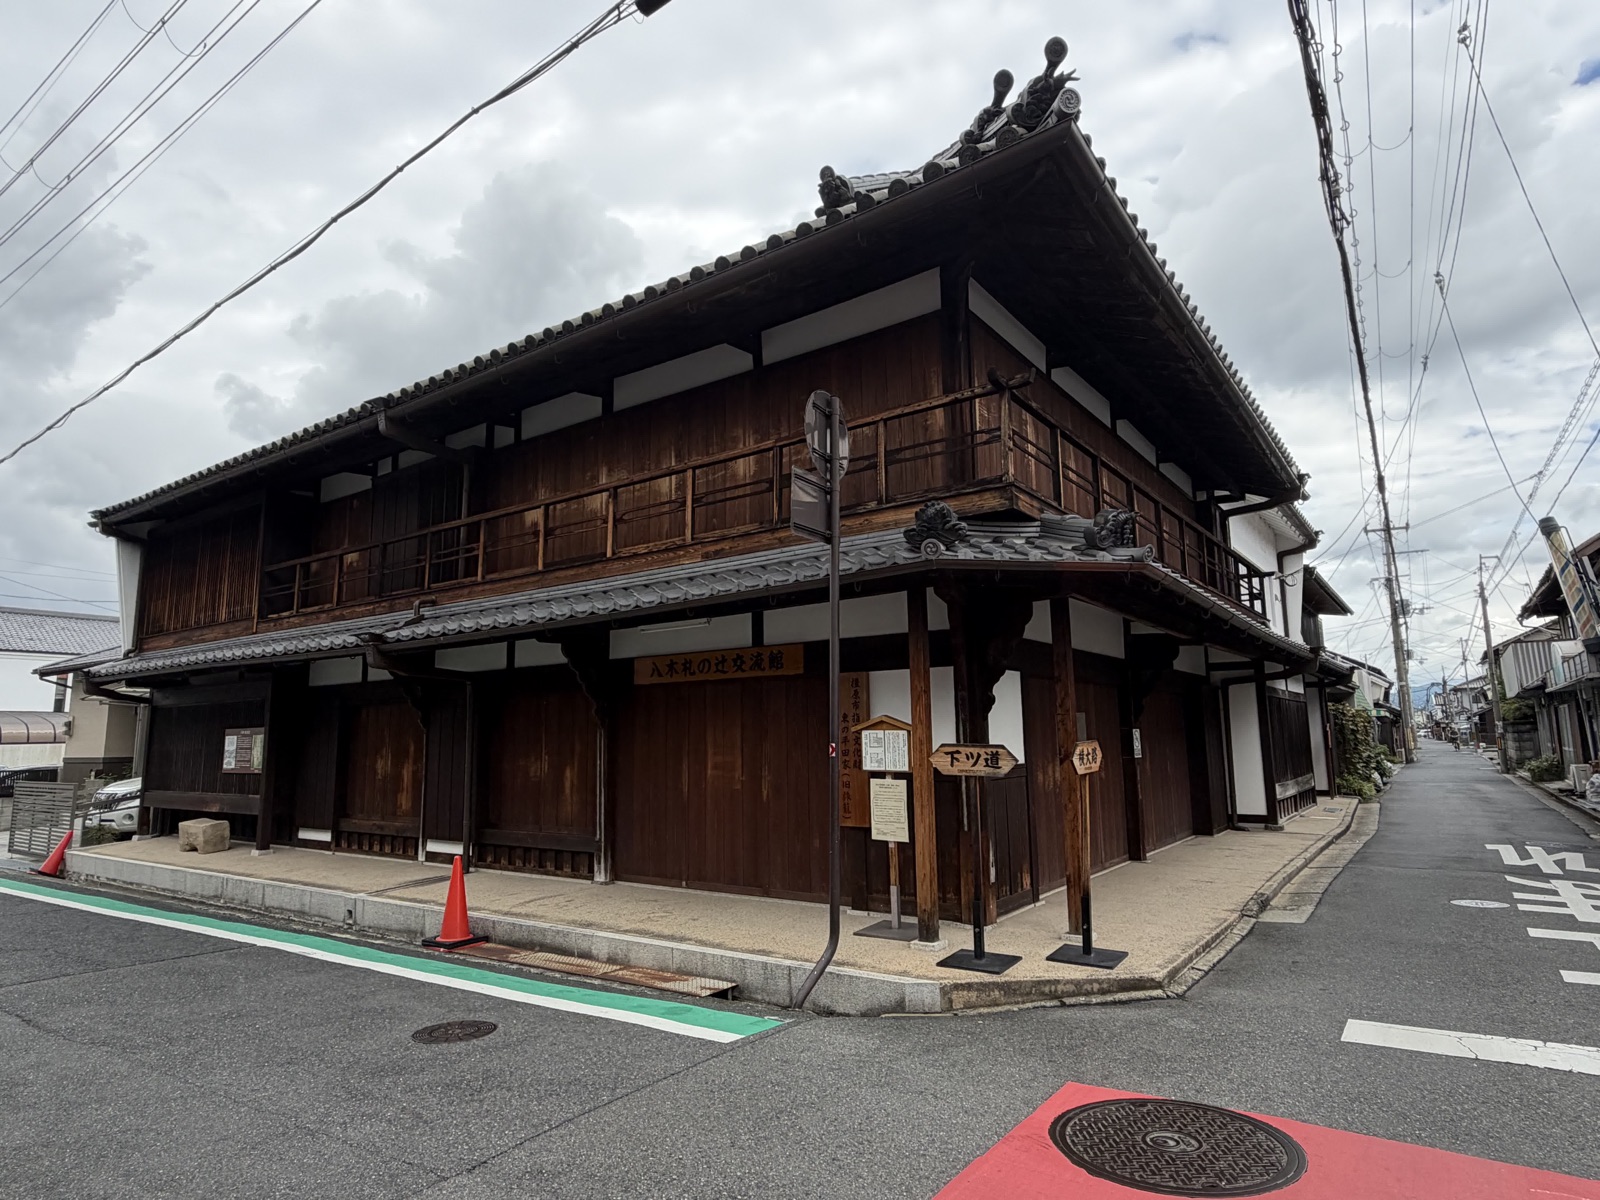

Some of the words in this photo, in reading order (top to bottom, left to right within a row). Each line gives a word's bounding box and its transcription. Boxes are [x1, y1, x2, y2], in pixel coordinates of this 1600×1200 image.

[650, 650, 785, 678] 八木札の辻交流館
[851, 678, 861, 770] 橿原市指文化財
[943, 749, 1003, 769] 下ツ道
